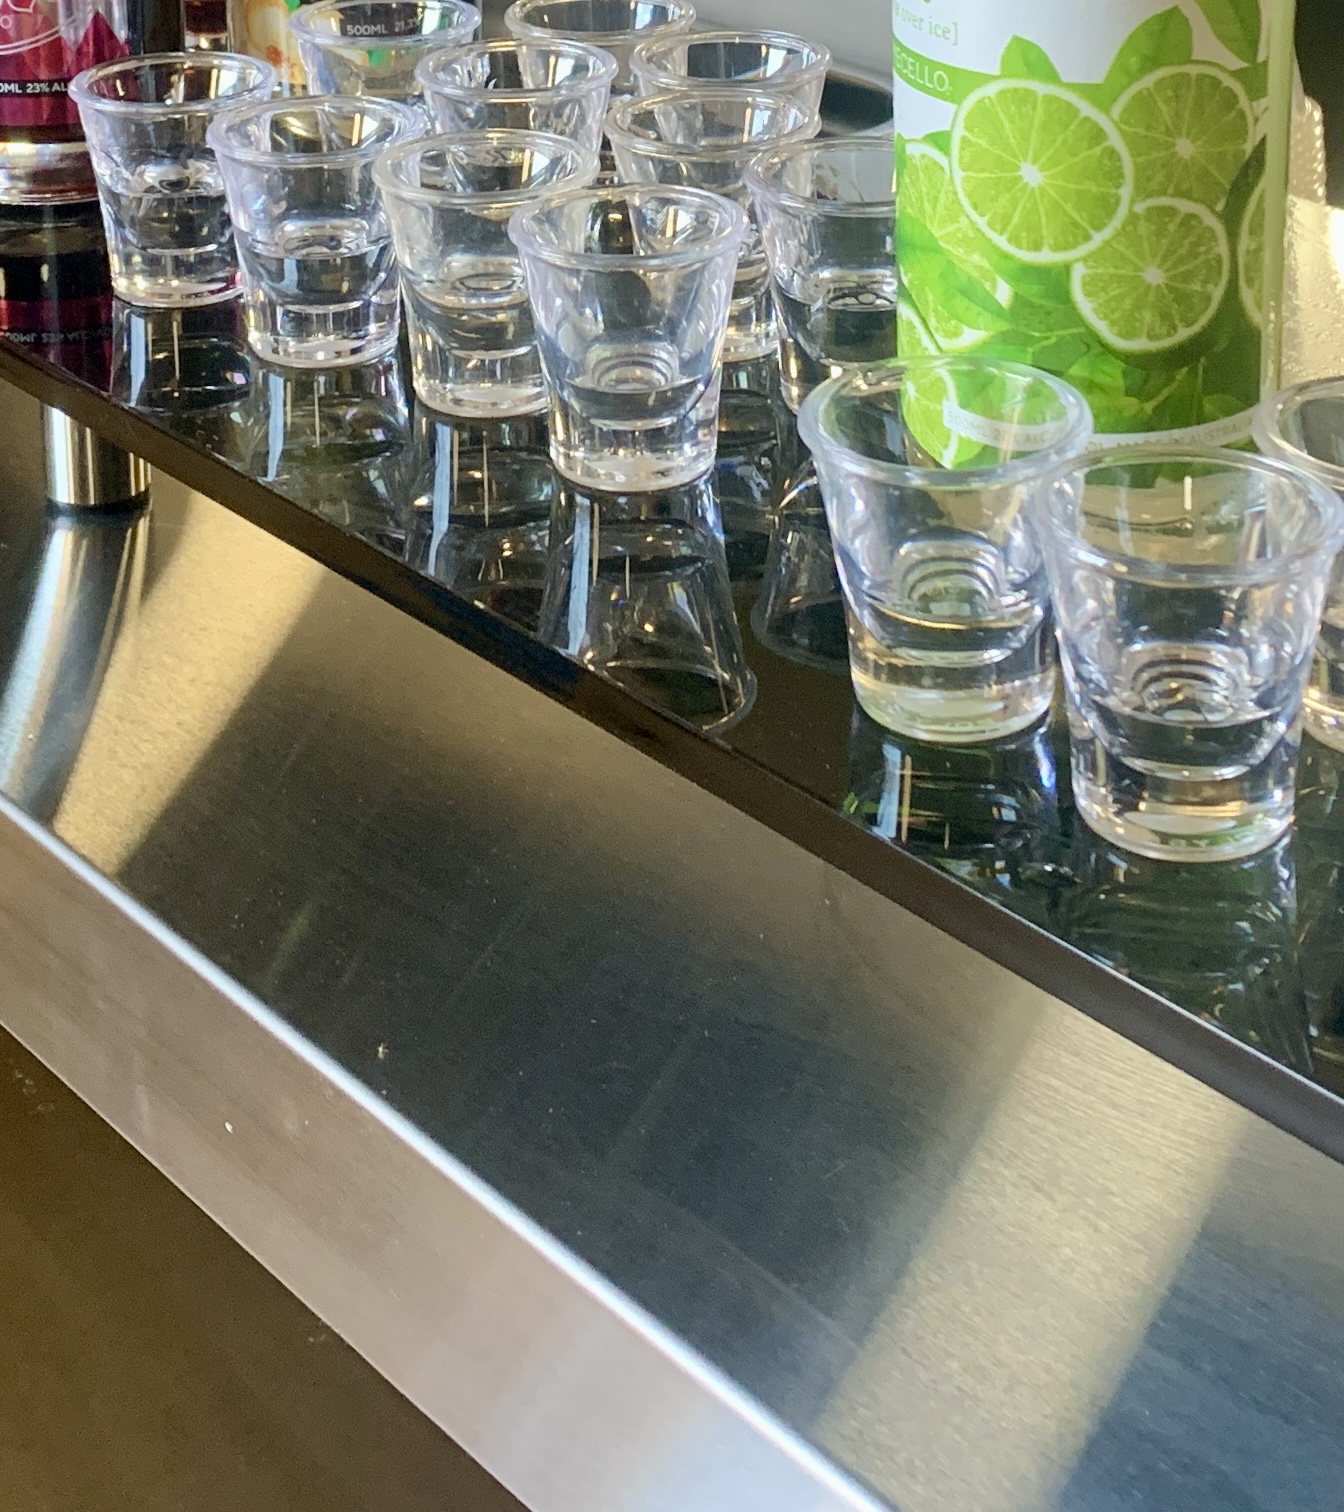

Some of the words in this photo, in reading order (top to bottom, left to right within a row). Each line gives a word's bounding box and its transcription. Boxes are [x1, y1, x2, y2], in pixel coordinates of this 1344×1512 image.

[346, 24, 389, 35] 500ML
[26, 83, 50, 93] 23%
[52, 82, 68, 92] AL
